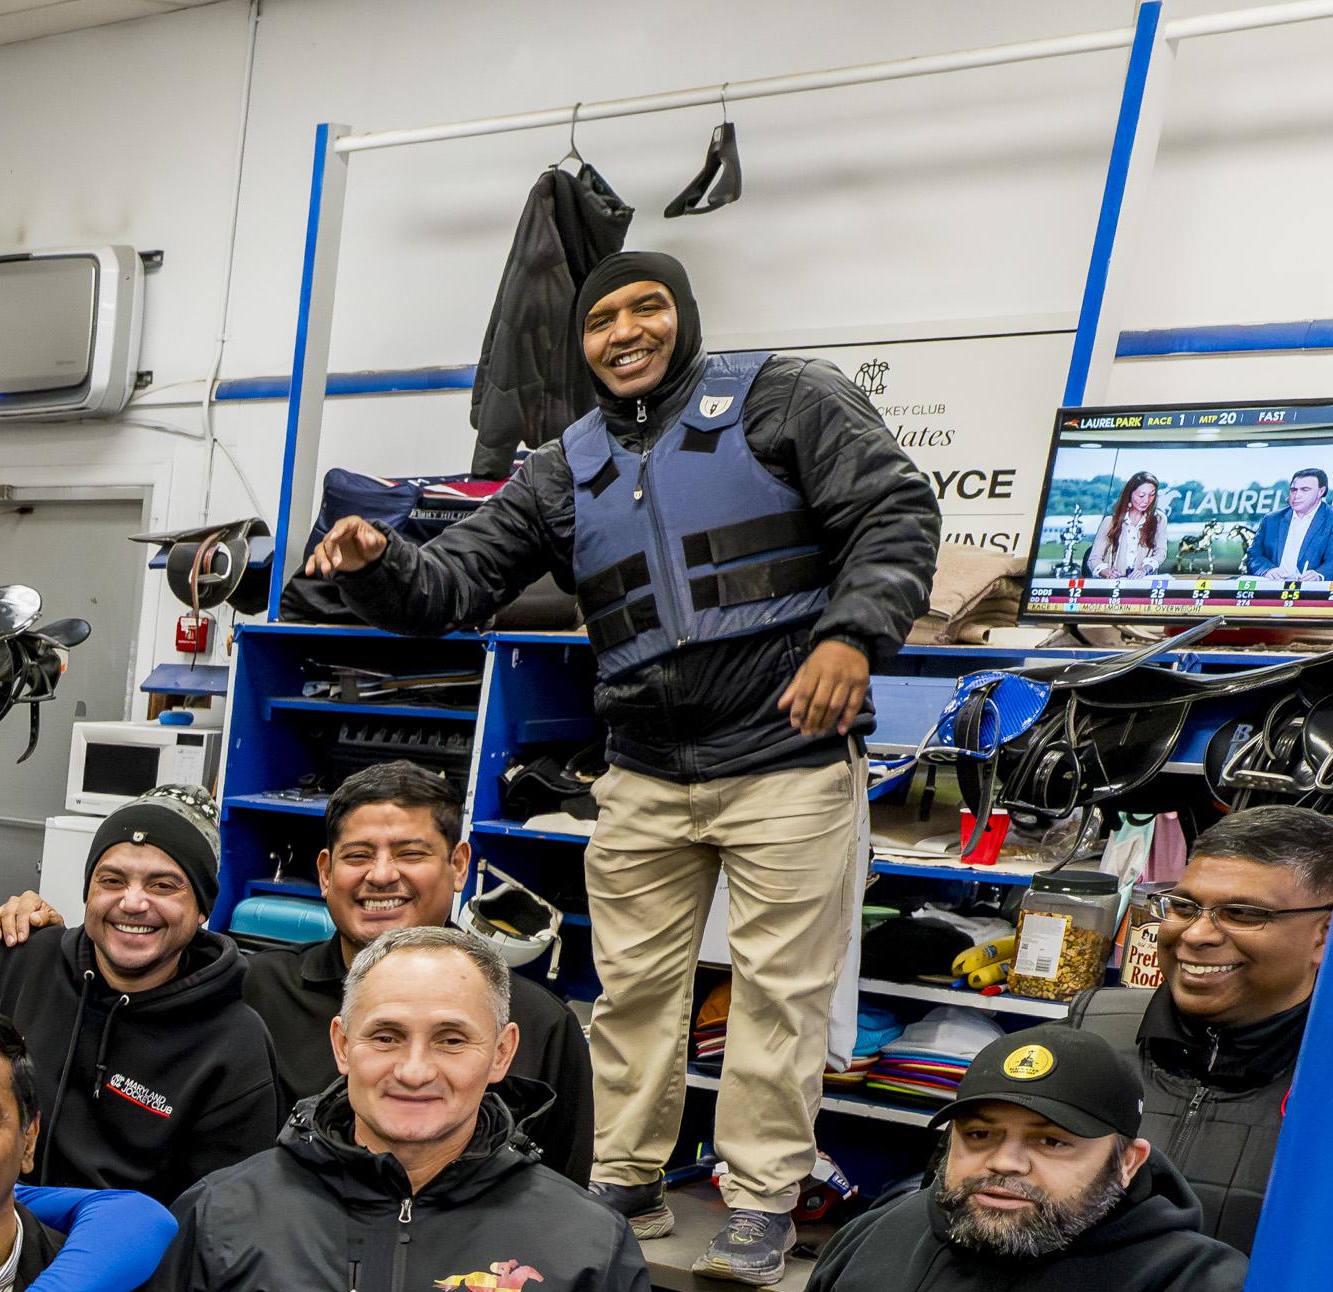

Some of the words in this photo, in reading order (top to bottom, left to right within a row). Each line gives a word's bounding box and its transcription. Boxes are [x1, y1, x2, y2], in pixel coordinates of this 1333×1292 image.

[911, 403, 946, 416] CLUB
[1148, 416, 1173, 426] RACE
[1199, 415, 1218, 424] MTP
[1218, 412, 1237, 425] 20
[1258, 411, 1286, 422] FAST
[921, 468, 1017, 500] YCE
[1031, 588, 1053, 596] ODDS
[1069, 588, 1082, 597] 12
[1112, 589, 1120, 598] 5
[1150, 589, 1165, 598] 25
[1192, 590, 1210, 599] 5-2
[1281, 591, 1300, 599] 8-5
[121, 1085, 152, 1106] JOCKEY
[151, 1100, 173, 1115] CLUB
[124, 1078, 166, 1104] MARYLAND
